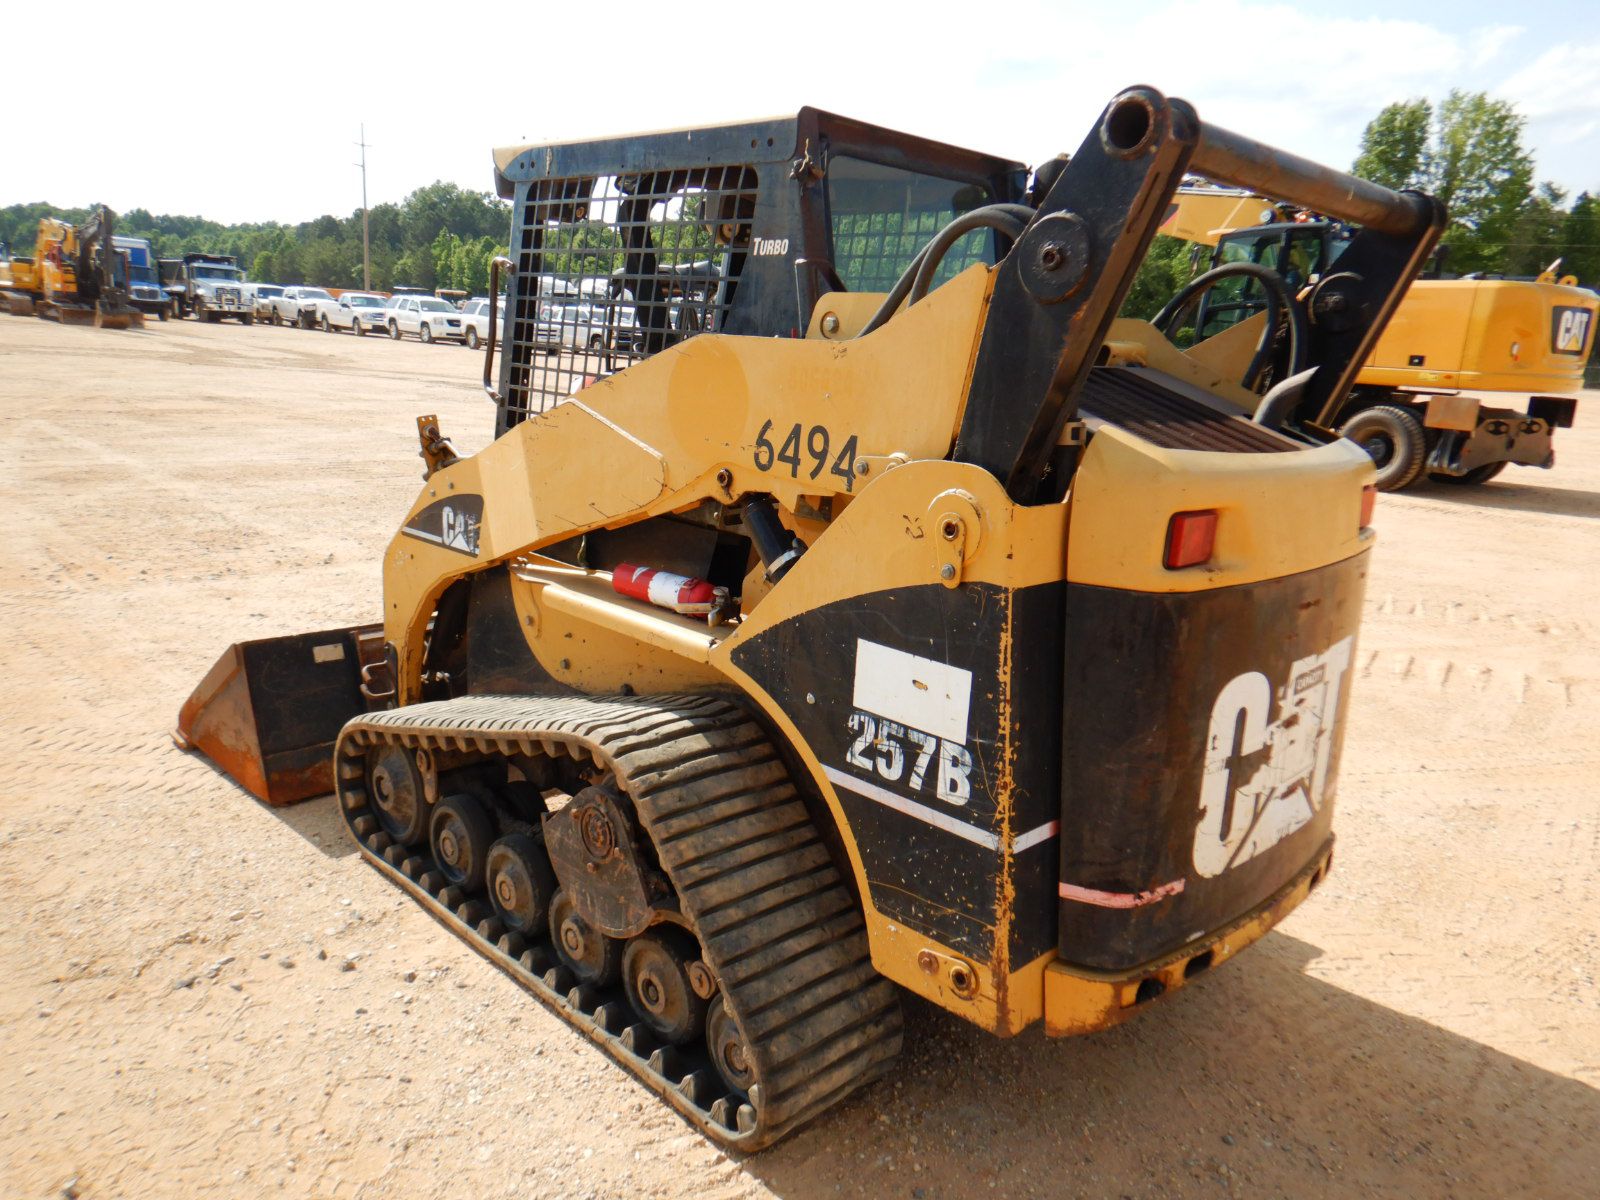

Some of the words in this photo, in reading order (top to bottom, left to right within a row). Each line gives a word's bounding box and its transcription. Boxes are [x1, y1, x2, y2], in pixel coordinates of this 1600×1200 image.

[754, 238, 788, 256] TURBO
[1557, 311, 1590, 351] CAT
[754, 419, 858, 492] 6494
[846, 711, 972, 806] 257B
[1193, 636, 1353, 878] CAT
